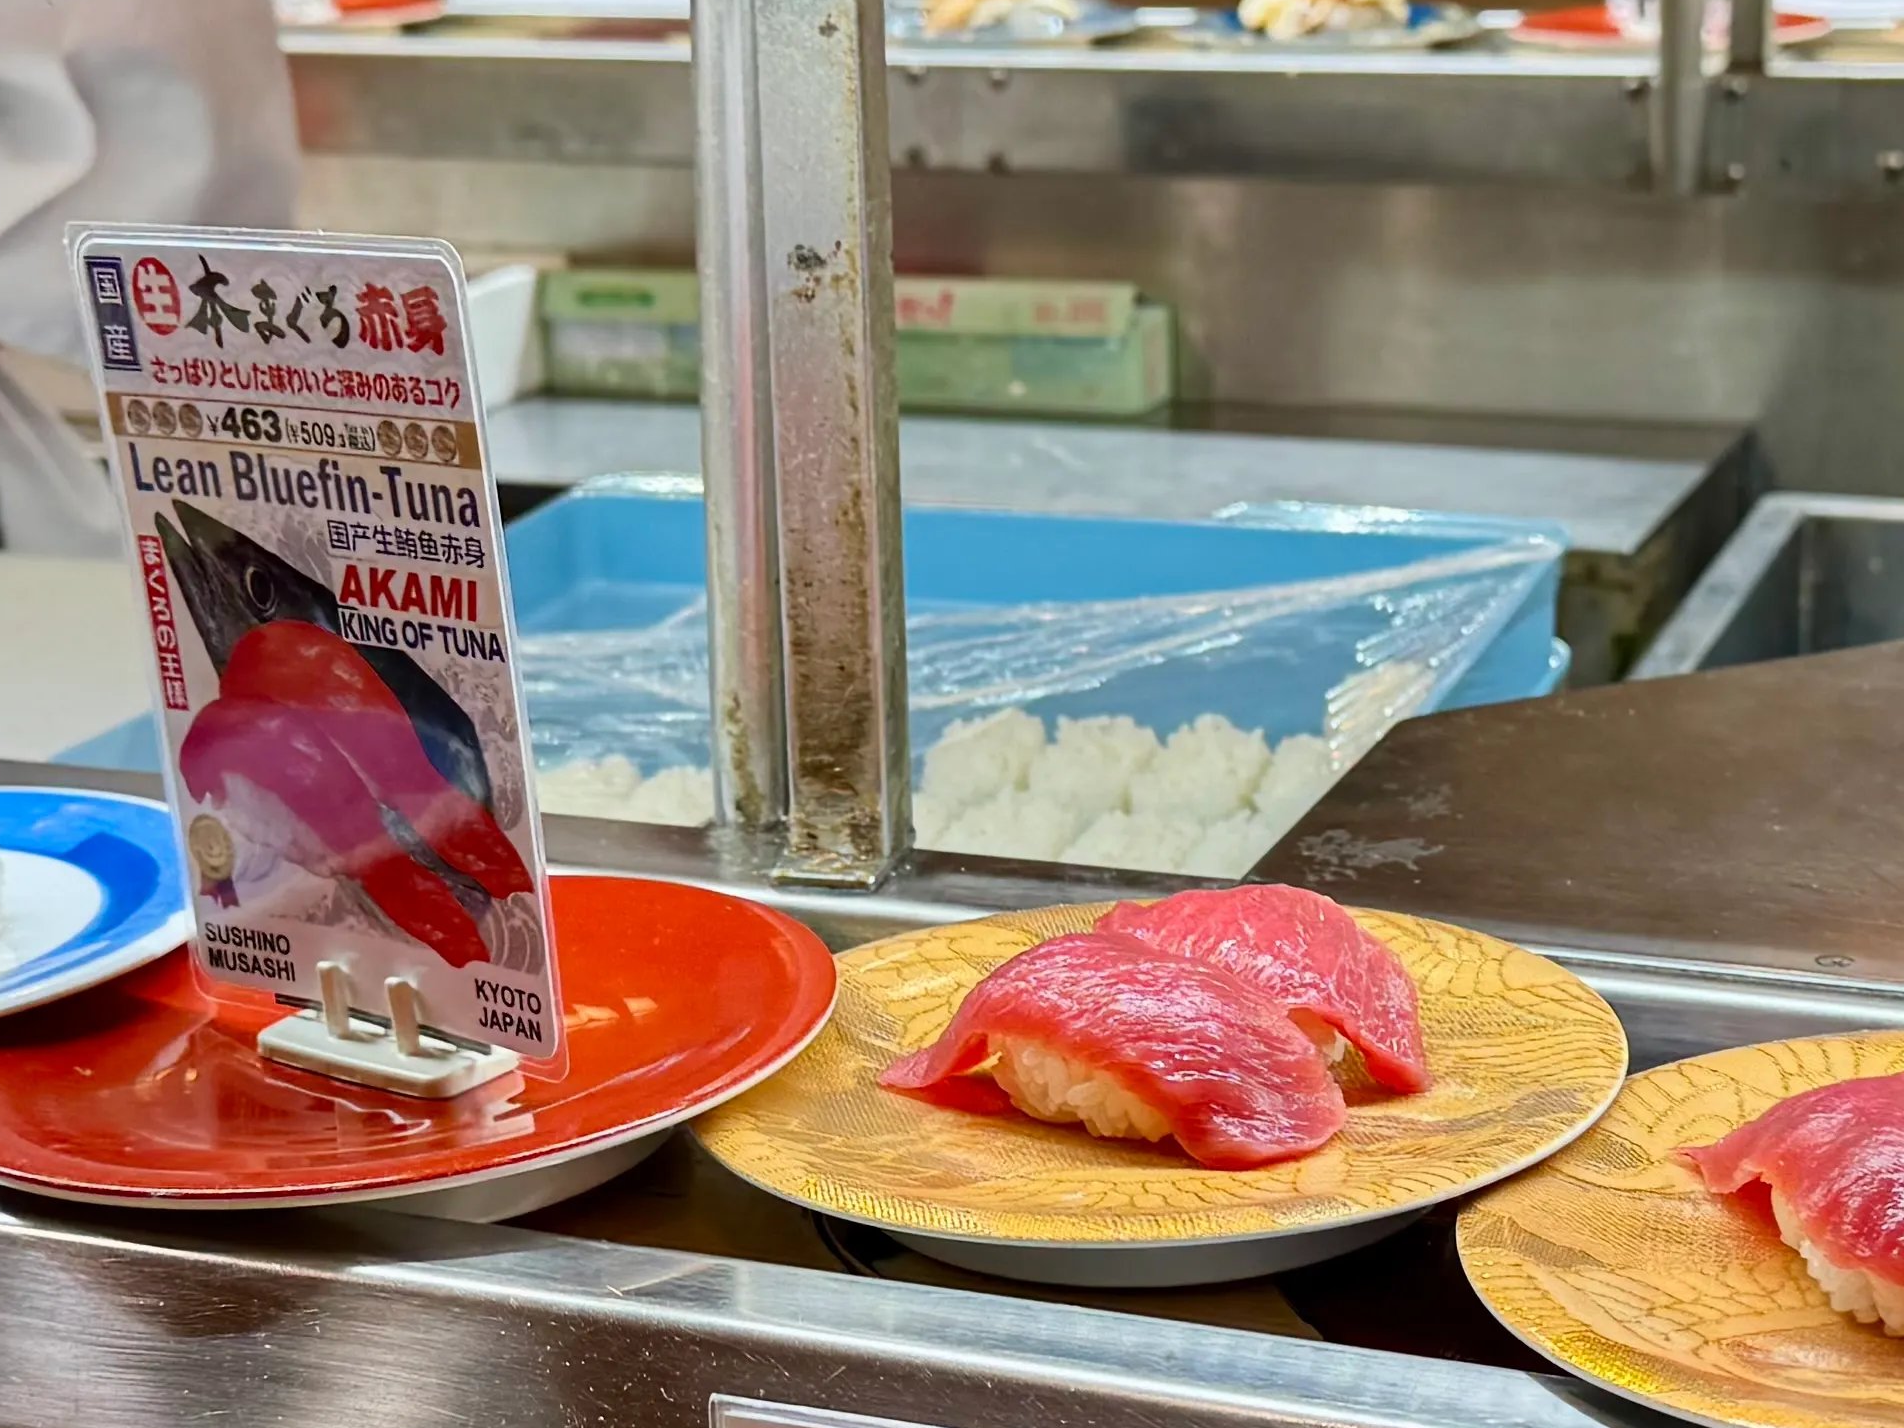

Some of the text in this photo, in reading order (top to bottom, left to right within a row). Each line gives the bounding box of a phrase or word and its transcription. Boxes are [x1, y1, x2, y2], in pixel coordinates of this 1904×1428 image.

[95, 267, 134, 363] 国産
[149, 356, 460, 411] さっぱりとした味わいと深みのあるコク
[206, 407, 282, 442] ¥463
[129, 442, 481, 528] Lean Bluefin-Tuna
[338, 563, 478, 623] AKAMI
[340, 607, 506, 663] KING OF TUNA
[205, 921, 291, 956] SUSHINO
[209, 946, 297, 982] MUSASHI
[474, 977, 542, 1015] KYOTO
[478, 1006, 543, 1043] JAPAN
